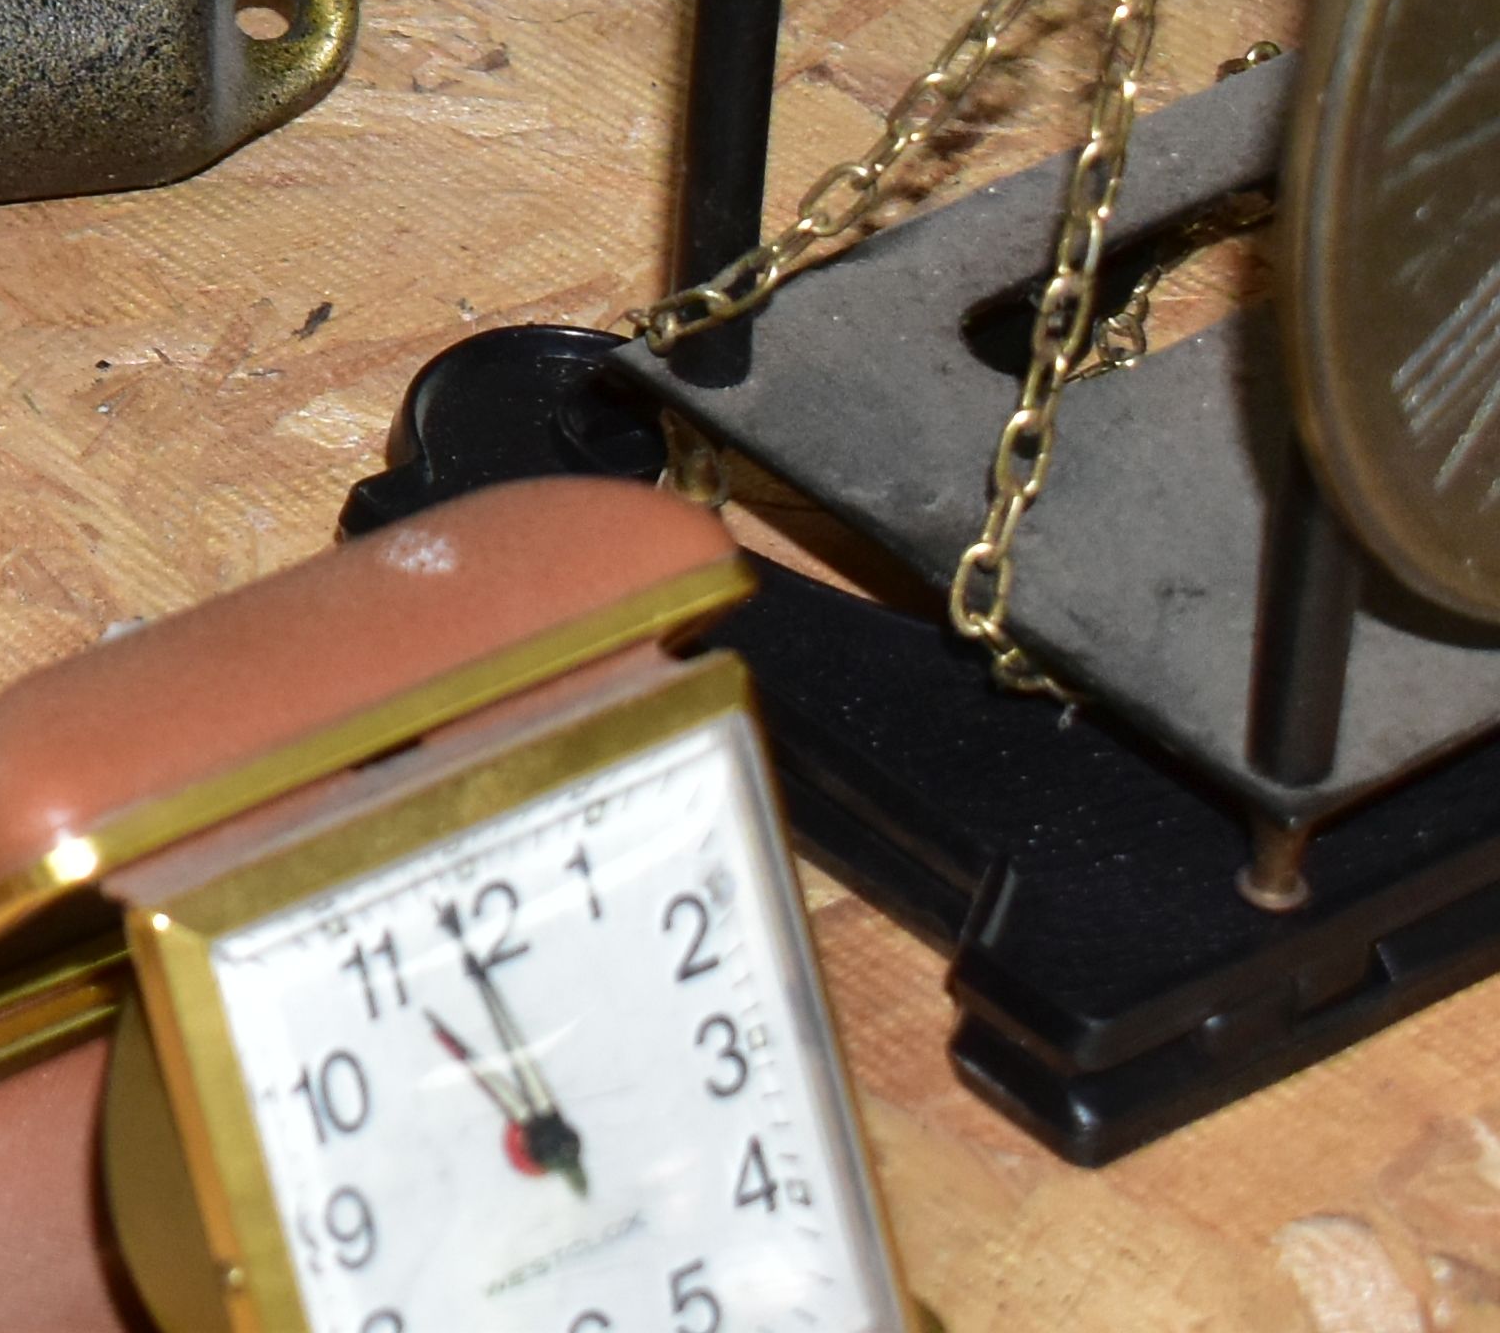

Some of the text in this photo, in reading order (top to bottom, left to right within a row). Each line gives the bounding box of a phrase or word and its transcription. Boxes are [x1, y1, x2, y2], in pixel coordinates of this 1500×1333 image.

[565, 840, 601, 921] 1
[341, 928, 409, 1021] 11
[662, 892, 722, 982] 2
[292, 1048, 372, 1143] 10
[693, 1013, 752, 1100] 3
[733, 1134, 779, 1215] 4
[325, 1186, 377, 1273] 9
[670, 1258, 724, 1333] 5
